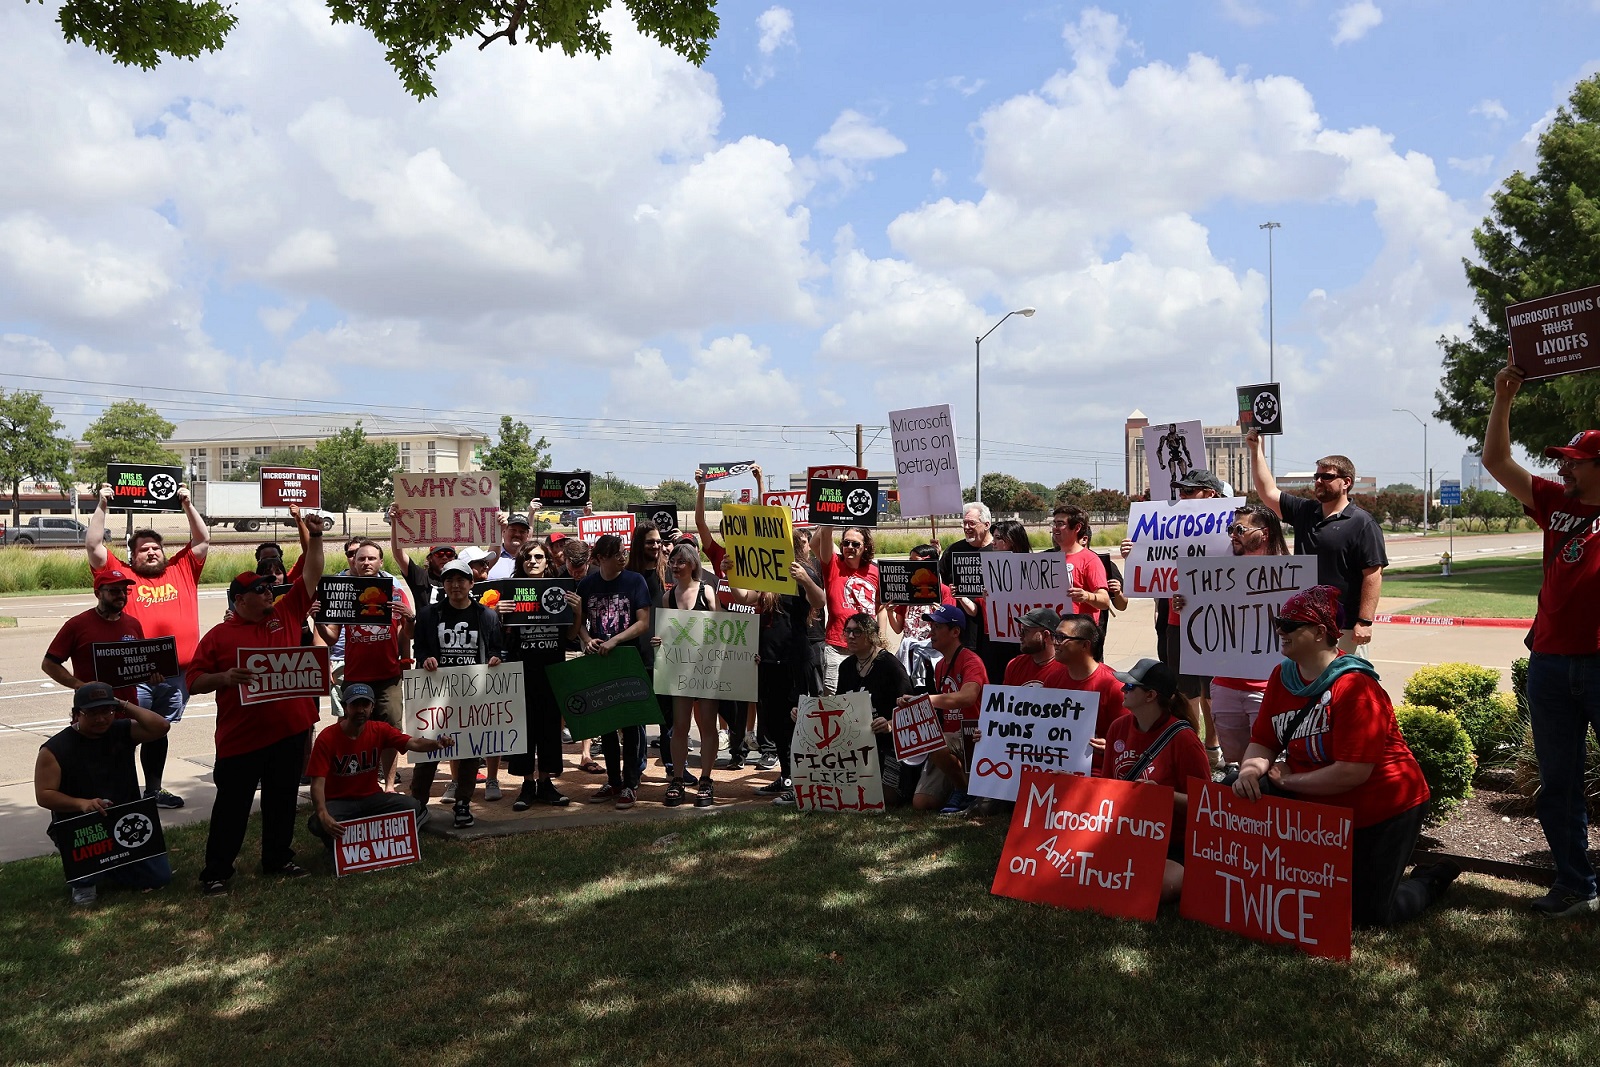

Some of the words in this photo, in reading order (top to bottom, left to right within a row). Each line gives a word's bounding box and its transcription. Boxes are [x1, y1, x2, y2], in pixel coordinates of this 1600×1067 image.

[1510, 305, 1559, 327] MICROSOFT
[1562, 298, 1594, 316] RUNS
[1541, 318, 1574, 336] TRUST
[1535, 332, 1589, 356] LAYOFFS
[892, 412, 949, 432] Microsoft
[895, 437, 927, 453] runs
[931, 434, 951, 449] on
[897, 452, 955, 476] betrayal.
[128, 479, 145, 487] XBOX
[262, 472, 296, 480] MICROSOFT
[115, 485, 147, 497] LAYOFF
[278, 488, 307, 498] LAYOFFS
[400, 478, 457, 498] WHY
[460, 476, 492, 497] SO
[540, 489, 564, 498] LAYOFF
[821, 487, 834, 496] THIS
[835, 488, 842, 496] IS
[766, 494, 807, 509] CWA
[816, 501, 846, 513] LAYOFF
[819, 494, 827, 502] AN
[828, 495, 843, 503] XBOX
[396, 507, 499, 544] SILENT
[581, 519, 601, 533] WHEN
[601, 518, 612, 532] WE
[612, 518, 631, 531] FIGHT
[724, 515, 748, 536] HOW
[753, 515, 785, 538] MANY
[1131, 510, 1235, 543] Microsoft
[1147, 545, 1179, 561] RUNS
[1187, 544, 1206, 557] ON
[735, 545, 787, 581] MORE
[956, 566, 983, 575] LAYOFFS
[883, 574, 909, 583] LAYOFFS
[960, 575, 981, 584] NEVER
[988, 559, 1013, 593] NO
[1020, 558, 1061, 590] MORE
[1186, 567, 1236, 595] THIS
[1246, 562, 1303, 590] CAN'T
[137, 583, 178, 598] CWA
[326, 591, 357, 601] LAYOFFS
[514, 587, 529, 595] THIS
[529, 587, 536, 595] IS
[886, 583, 907, 592] NEVER
[958, 584, 983, 593] CHANGE
[136, 590, 178, 608] organize!
[329, 600, 353, 609] NEVER
[513, 594, 522, 602] AN
[521, 594, 538, 602] XBOX
[884, 592, 910, 601] CHANGE
[325, 609, 356, 618] CHANGE
[514, 601, 541, 613] AYOFF
[727, 602, 756, 615] LAYOFFS
[1374, 615, 1392, 623] LANE
[1409, 616, 1420, 624] NO
[1421, 617, 1453, 625] PARKING
[437, 621, 479, 649] bfu
[96, 647, 138, 657] MICROSOFT
[140, 644, 161, 654] RUNS
[538, 640, 559, 649] CWA
[123, 655, 148, 664] TRUST
[246, 651, 322, 674] CWA
[456, 656, 477, 665] CWA
[662, 647, 704, 664] KILLS
[707, 649, 755, 662] CREATIVITY
[117, 662, 156, 676] LAYOFFS
[693, 664, 720, 675] NOT
[247, 670, 323, 694] STRONG
[421, 673, 479, 699] AWARDS
[485, 672, 522, 695] DONT
[677, 675, 732, 692] BONUSES
[985, 692, 1085, 720] Microsoft
[416, 706, 454, 731] STOP
[458, 700, 513, 729] LAYOFFS
[895, 706, 914, 730] WHEN
[896, 728, 919, 749] We
[916, 718, 941, 742] Win!
[987, 720, 1035, 739] runs
[1048, 727, 1072, 742] on
[794, 746, 874, 769] FIGHT
[1006, 742, 1068, 767] TRUST
[810, 771, 857, 784] LIKE
[794, 784, 884, 811] HELL
[1023, 782, 1114, 833] Microsoft
[1117, 815, 1166, 841] runs
[1195, 784, 1273, 838] Achievement
[1275, 806, 1352, 850] Unlocked!
[74, 825, 94, 839] THIS
[95, 822, 104, 832] IS
[341, 822, 367, 845] WHEN
[369, 820, 385, 842] WE
[384, 815, 409, 840] FIGHT
[73, 837, 86, 848] AN
[86, 830, 108, 844] XBOX
[72, 837, 114, 863] LAYOFF
[342, 844, 371, 865] We
[371, 835, 413, 859] Win!
[1192, 830, 1223, 863] Laid
[1224, 841, 1242, 867] off
[1243, 845, 1260, 878] by
[1010, 855, 1037, 877] on
[1075, 851, 1135, 890] Trust
[1215, 870, 1321, 945] TWICE
